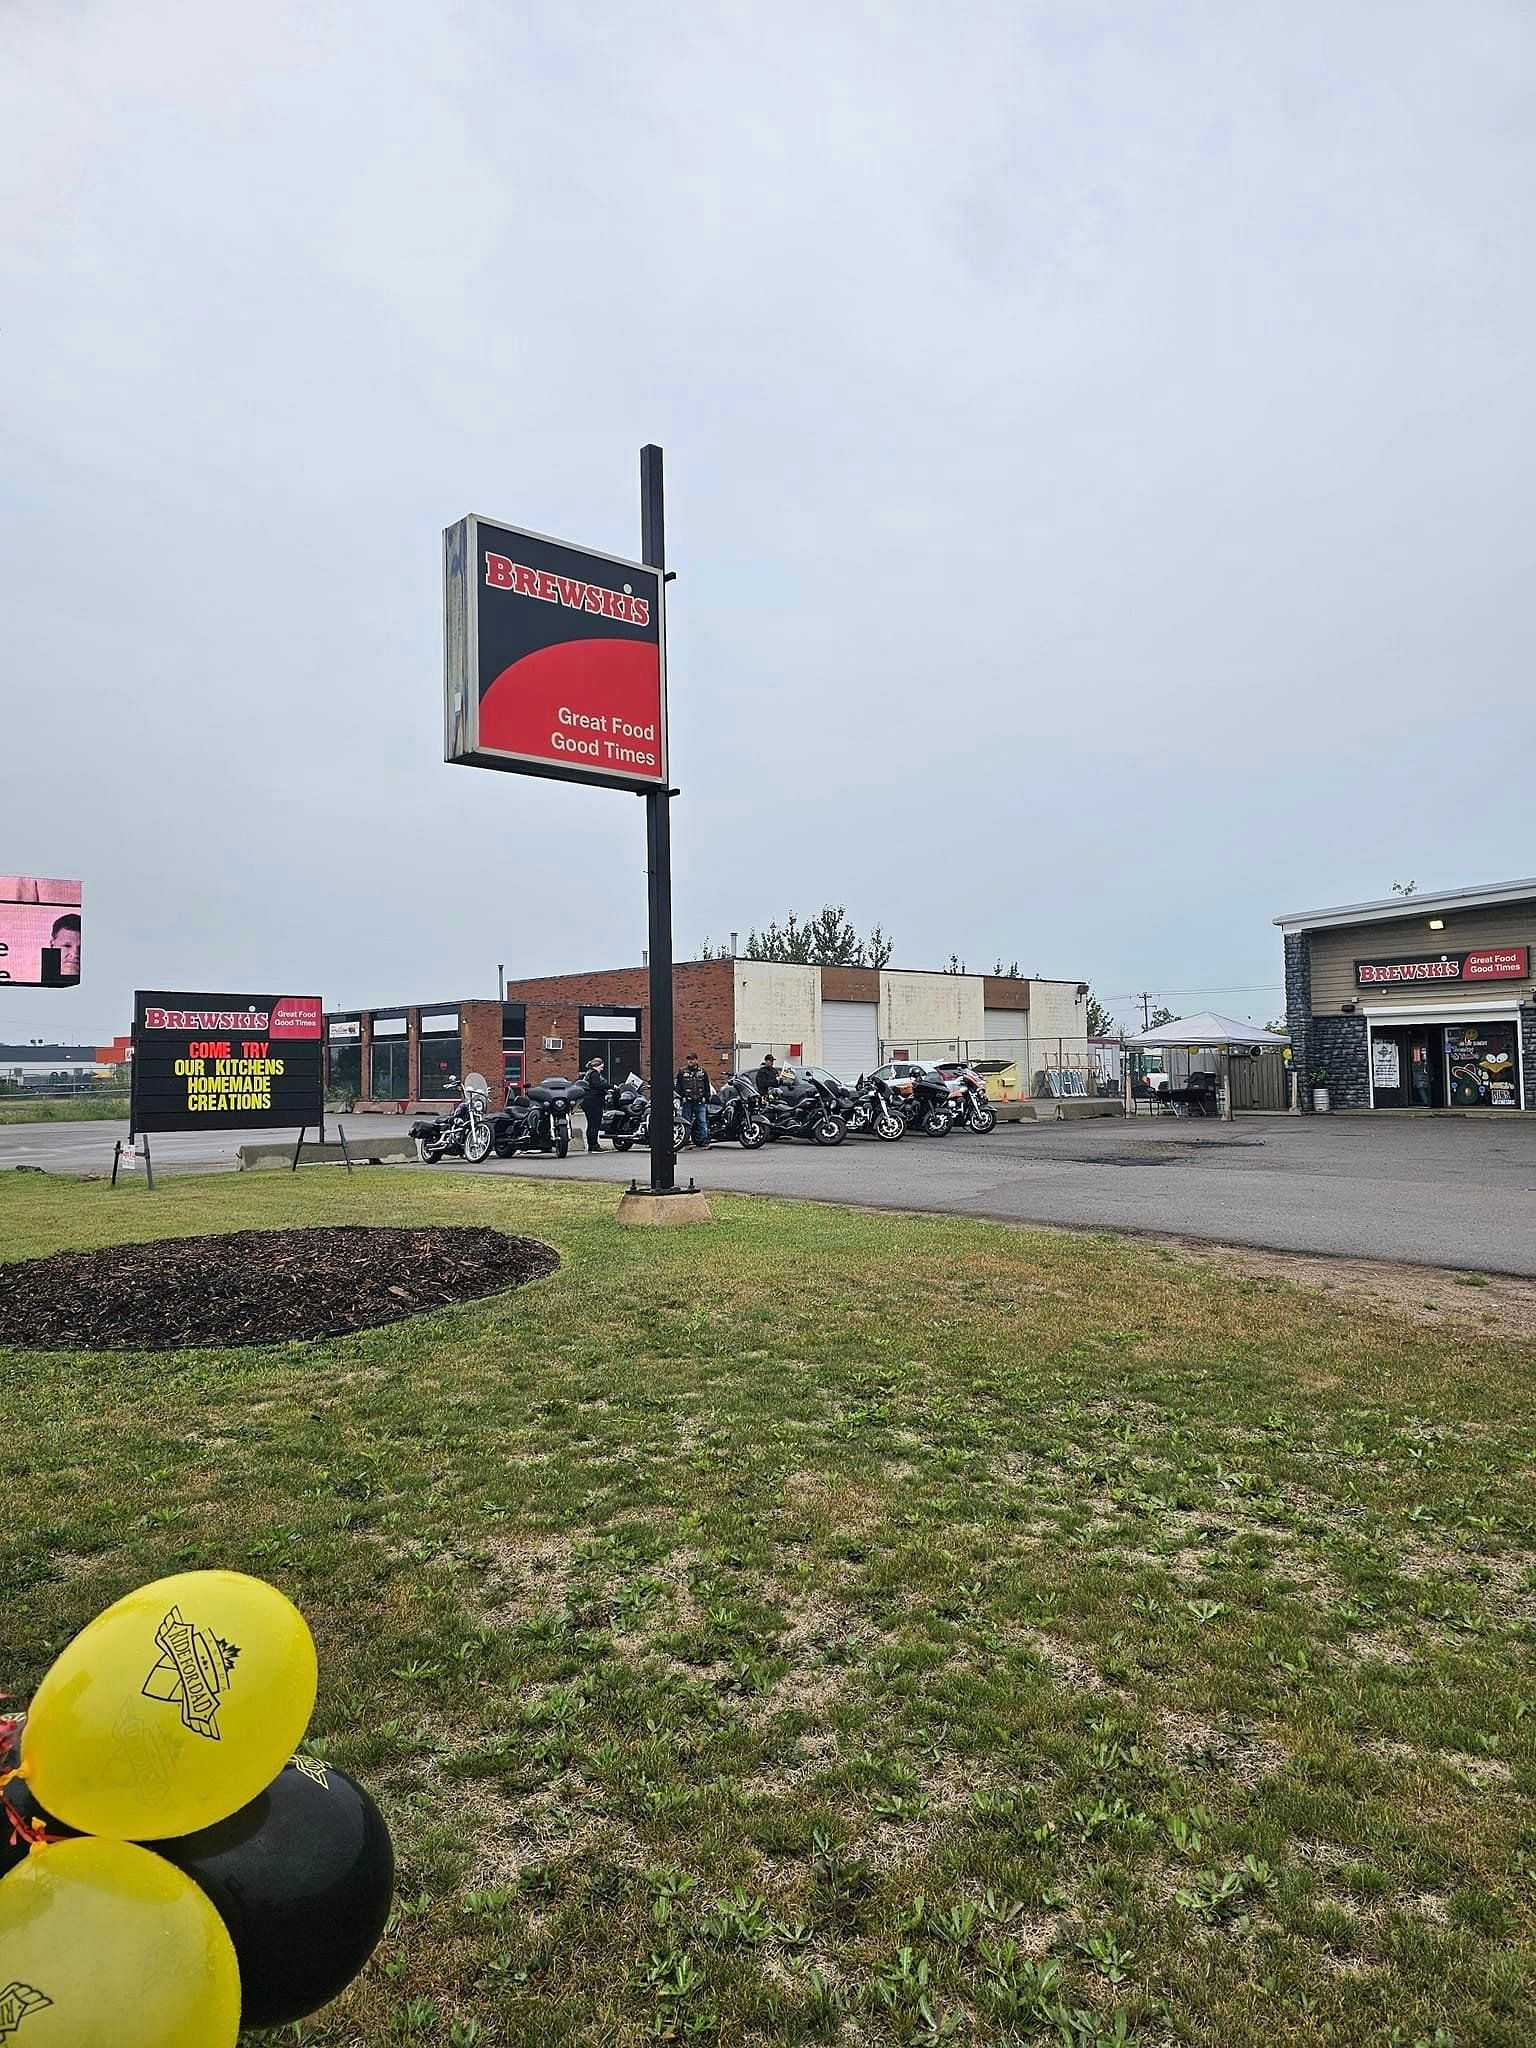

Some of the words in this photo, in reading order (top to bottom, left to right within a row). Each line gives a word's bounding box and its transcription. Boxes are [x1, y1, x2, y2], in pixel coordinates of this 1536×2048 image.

[485, 552, 649, 627] BREWSKIS
[558, 707, 607, 732] Great
[612, 717, 654, 741] Food
[551, 732, 599, 756] Good
[604, 742, 655, 766] Times
[1358, 955, 1459, 982] BREWSKIS
[1470, 956, 1493, 965] Great
[1495, 954, 1516, 963] Food
[1470, 965, 1493, 973] Good
[1495, 963, 1521, 972] Times
[145, 1005, 269, 1030] BREWSKIS
[274, 1019, 294, 1027] Good
[295, 1019, 316, 1027] Times
[277, 1010, 296, 1018] Great
[298, 1010, 316, 1018] Food
[189, 1042, 231, 1058] COME
[241, 1042, 269, 1058] TRY
[174, 1059, 205, 1076] OUR
[215, 1059, 285, 1076] KITCHENS
[187, 1076, 271, 1094] HOMEMADE
[187, 1093, 271, 1111] CREATIONS
[168, 1628, 191, 1660] RIDE
[180, 1658, 199, 1683] FOR
[188, 1682, 213, 1713] DAD
